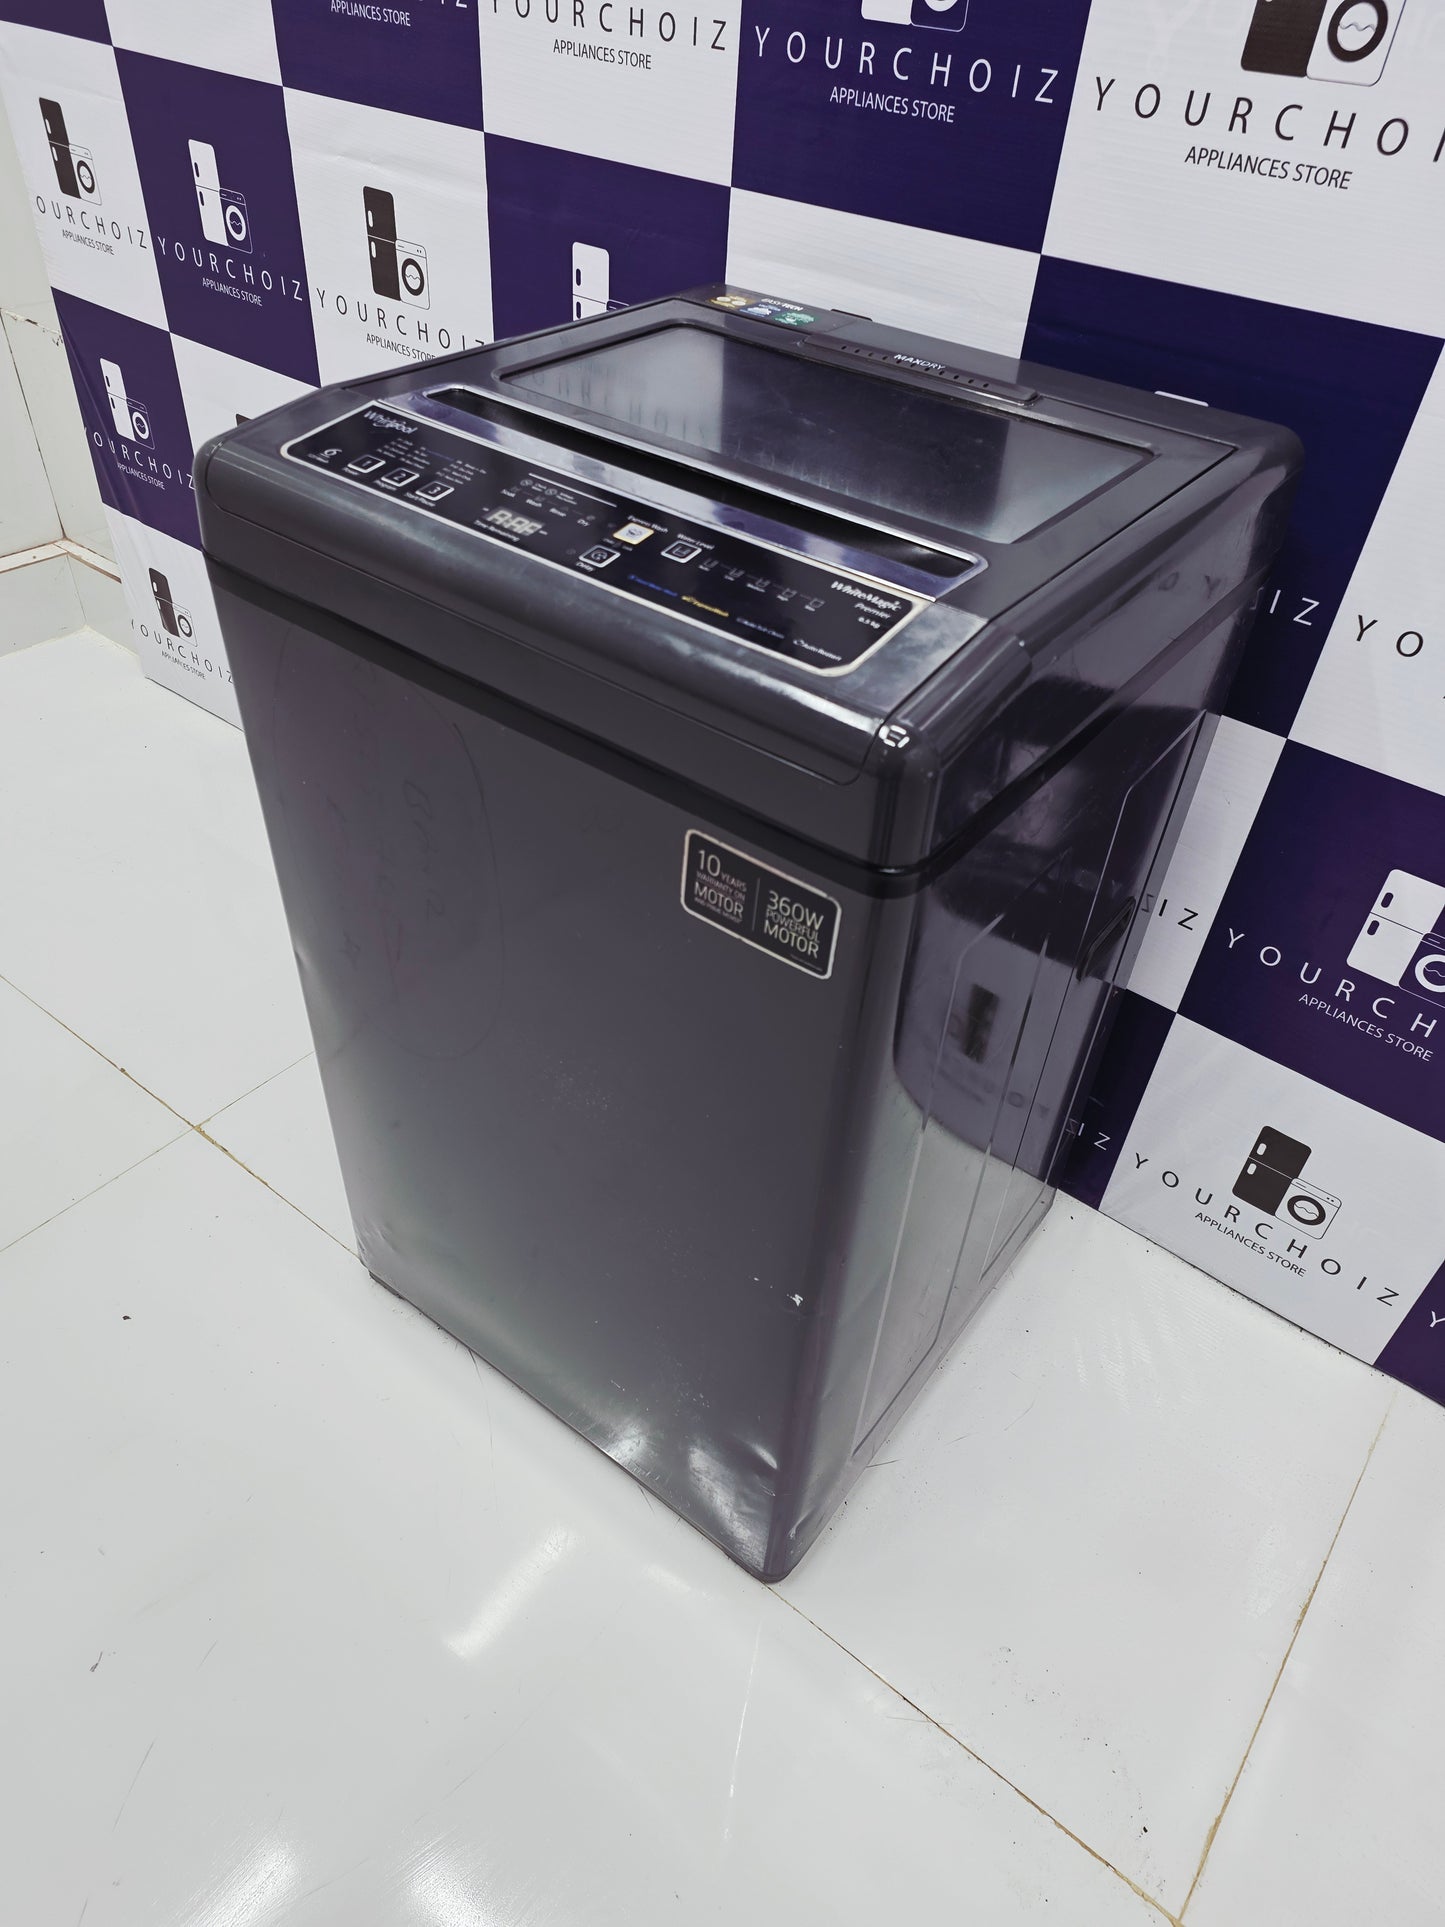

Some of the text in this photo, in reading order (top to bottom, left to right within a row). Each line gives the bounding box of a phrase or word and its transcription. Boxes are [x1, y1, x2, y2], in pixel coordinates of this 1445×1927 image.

[331, 0, 411, 27] APPLIANCES STORE
[553, 39, 652, 70] APPLIANCES STORE
[755, 25, 1058, 103] YOURCHOIZ
[830, 86, 955, 123] APPLIANCES STORE
[1185, 146, 1353, 191] APPLIANCES STORE
[62, 229, 115, 256] APPLIANCES STORE
[157, 236, 304, 302] YOURCHOIZ
[202, 277, 263, 307] APPLIANCES STORE
[366, 333, 411, 357] APPLIANCES
[893, 353, 946, 370] MAXDRY
[363, 410, 418, 435] Whirlpool
[93, 431, 196, 490] OURCHOIZ
[147, 475, 165, 490] STORE
[831, 580, 902, 612] WhiteMagic
[854, 602, 892, 620] Premier
[699, 850, 747, 892] 10 YEARS
[694, 881, 744, 919] MOTOR
[734, 888, 746, 902] ON
[767, 890, 824, 930] 360W
[764, 919, 819, 959] MOTOR
[766, 908, 820, 943] POWERFUL
[1298, 994, 1434, 1062] APPLIANCES STORE
[1135, 1152, 1399, 1307] YOURCHOIZ
[1195, 1211, 1307, 1278] APPLIANCES STORE
